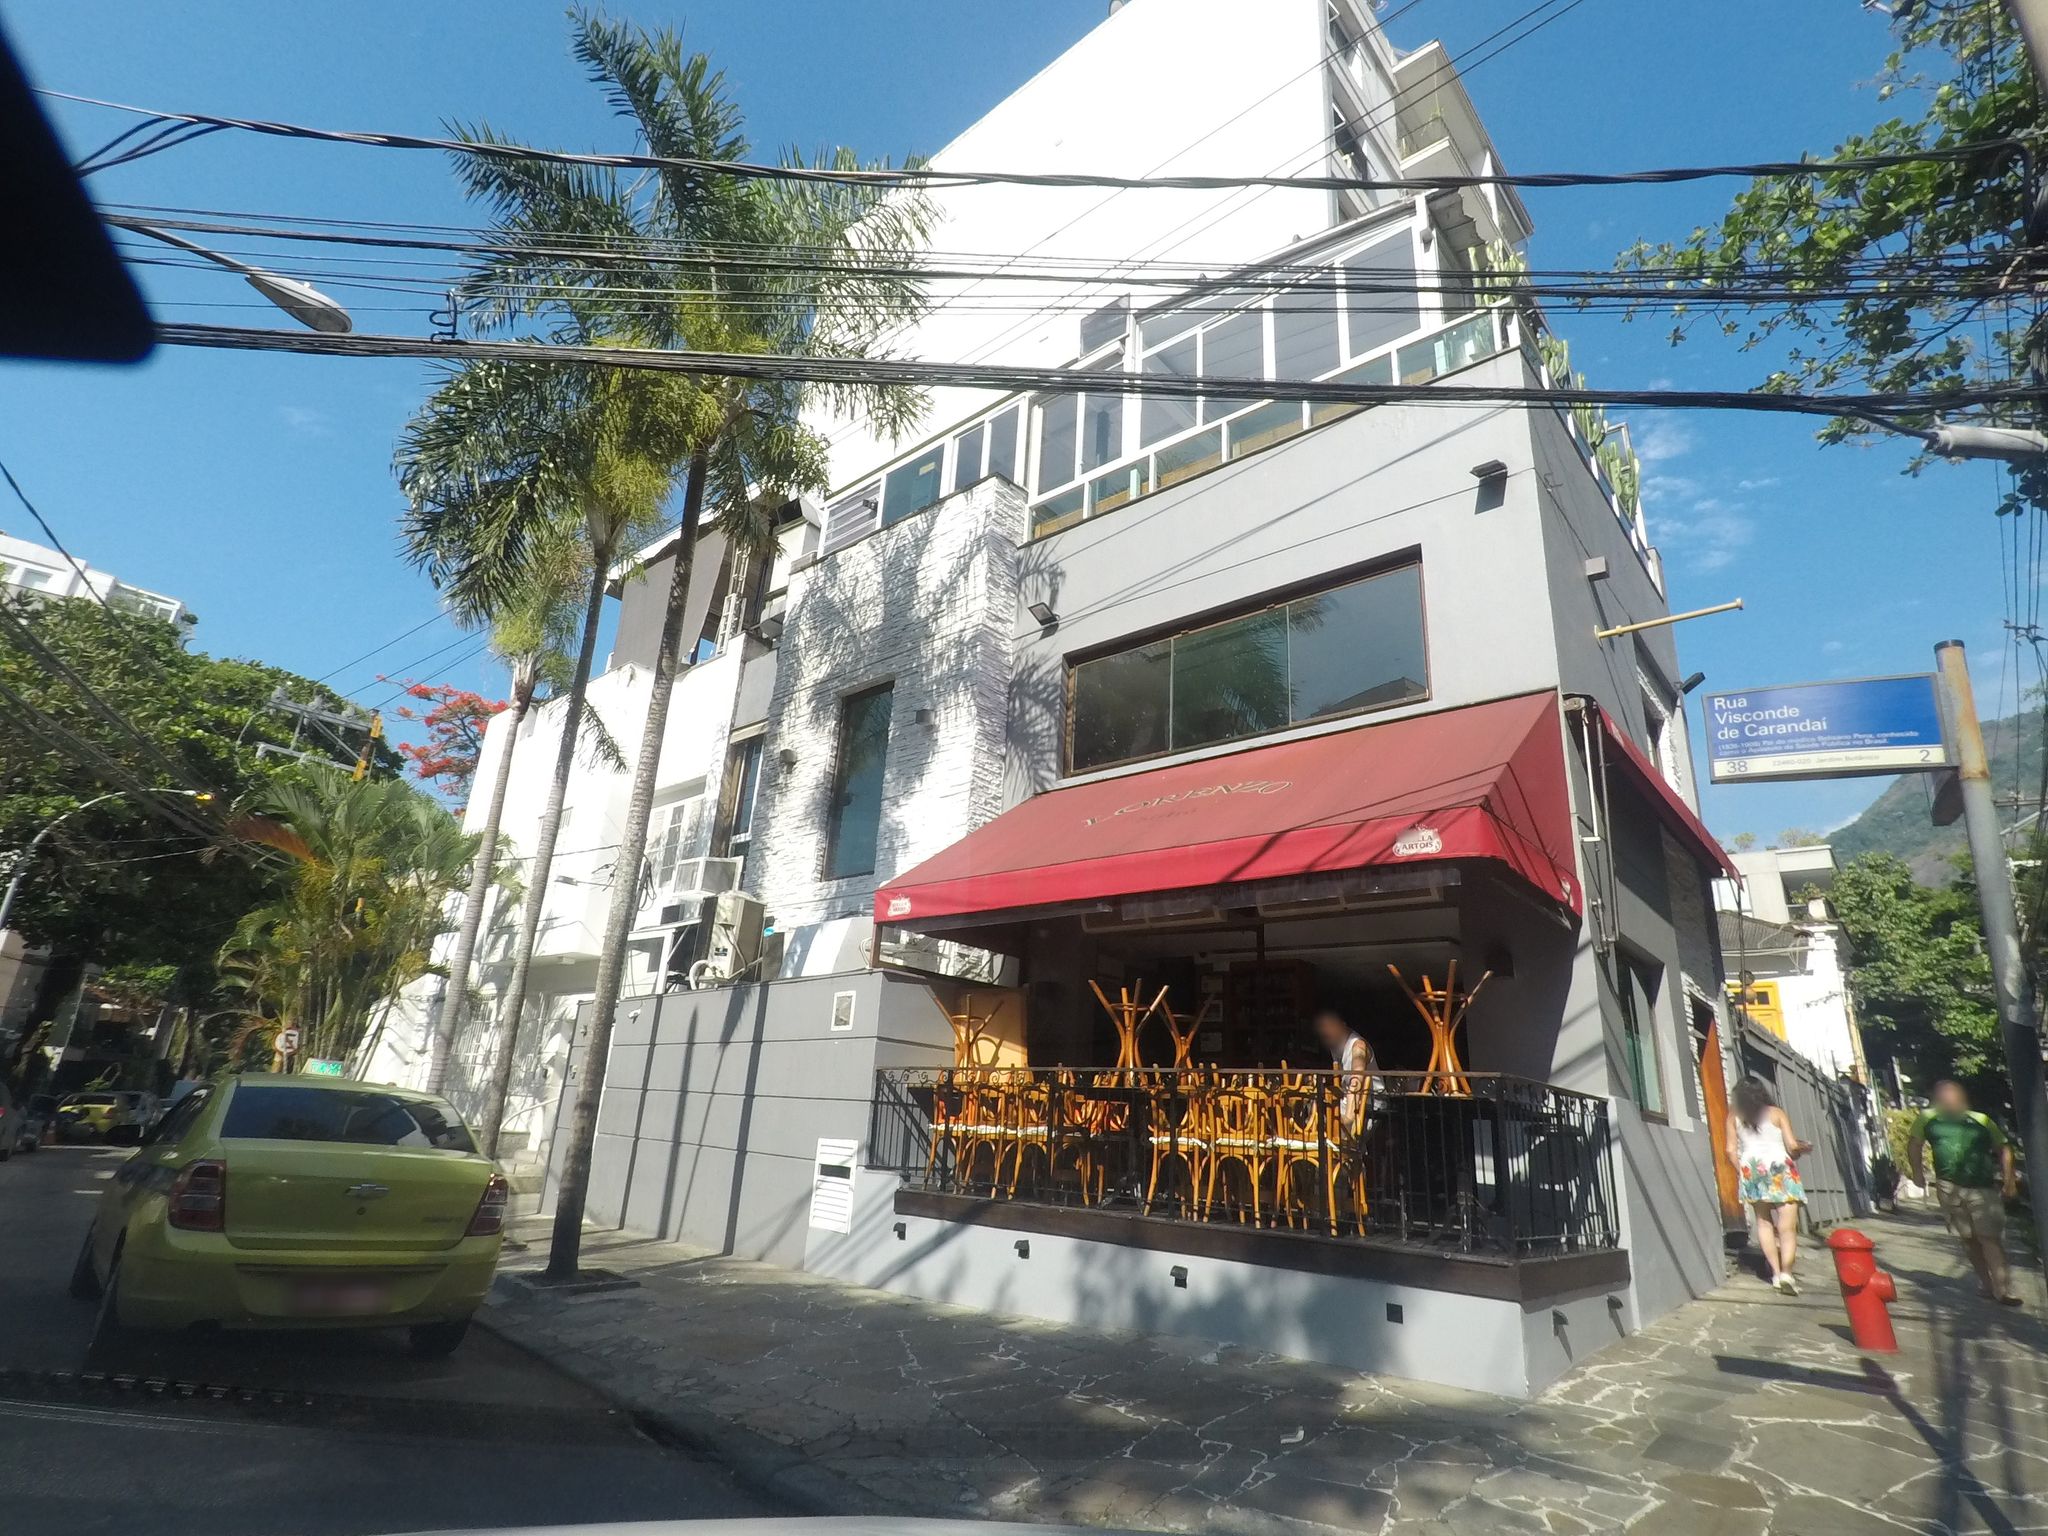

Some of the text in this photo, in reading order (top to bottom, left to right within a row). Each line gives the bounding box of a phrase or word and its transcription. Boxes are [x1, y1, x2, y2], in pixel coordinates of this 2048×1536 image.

[1714, 697, 1747, 710] Rua
[1714, 705, 1800, 725] Visconde
[1717, 716, 1827, 740] de Carandaí
[1726, 760, 1748, 774] 38
[1919, 749, 1932, 762] 2
[1402, 841, 1433, 851] ARTOIS
